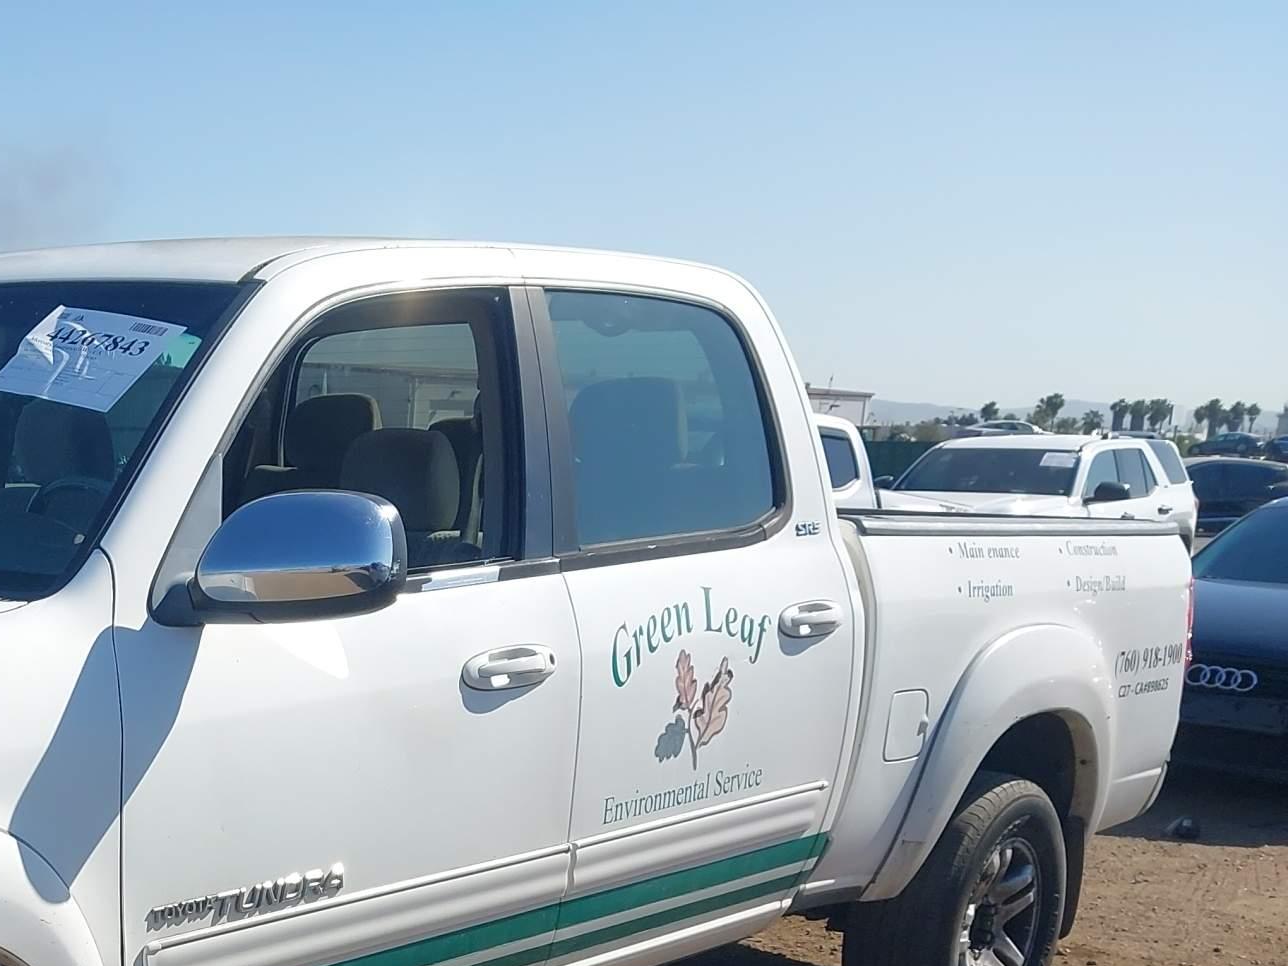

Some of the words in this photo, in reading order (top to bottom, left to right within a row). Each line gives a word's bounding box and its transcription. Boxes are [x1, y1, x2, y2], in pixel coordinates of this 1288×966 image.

[46, 326, 150, 357] 44267843
[968, 579, 1014, 603] Irrigation
[611, 598, 692, 688] Green
[700, 585, 772, 664] Leaf
[1114, 650, 1141, 680] (760)
[1142, 642, 1183, 670] 918-1900
[602, 773, 710, 825] Environmental
[713, 763, 763, 798] Service
[151, 896, 216, 923] TOYOTA
